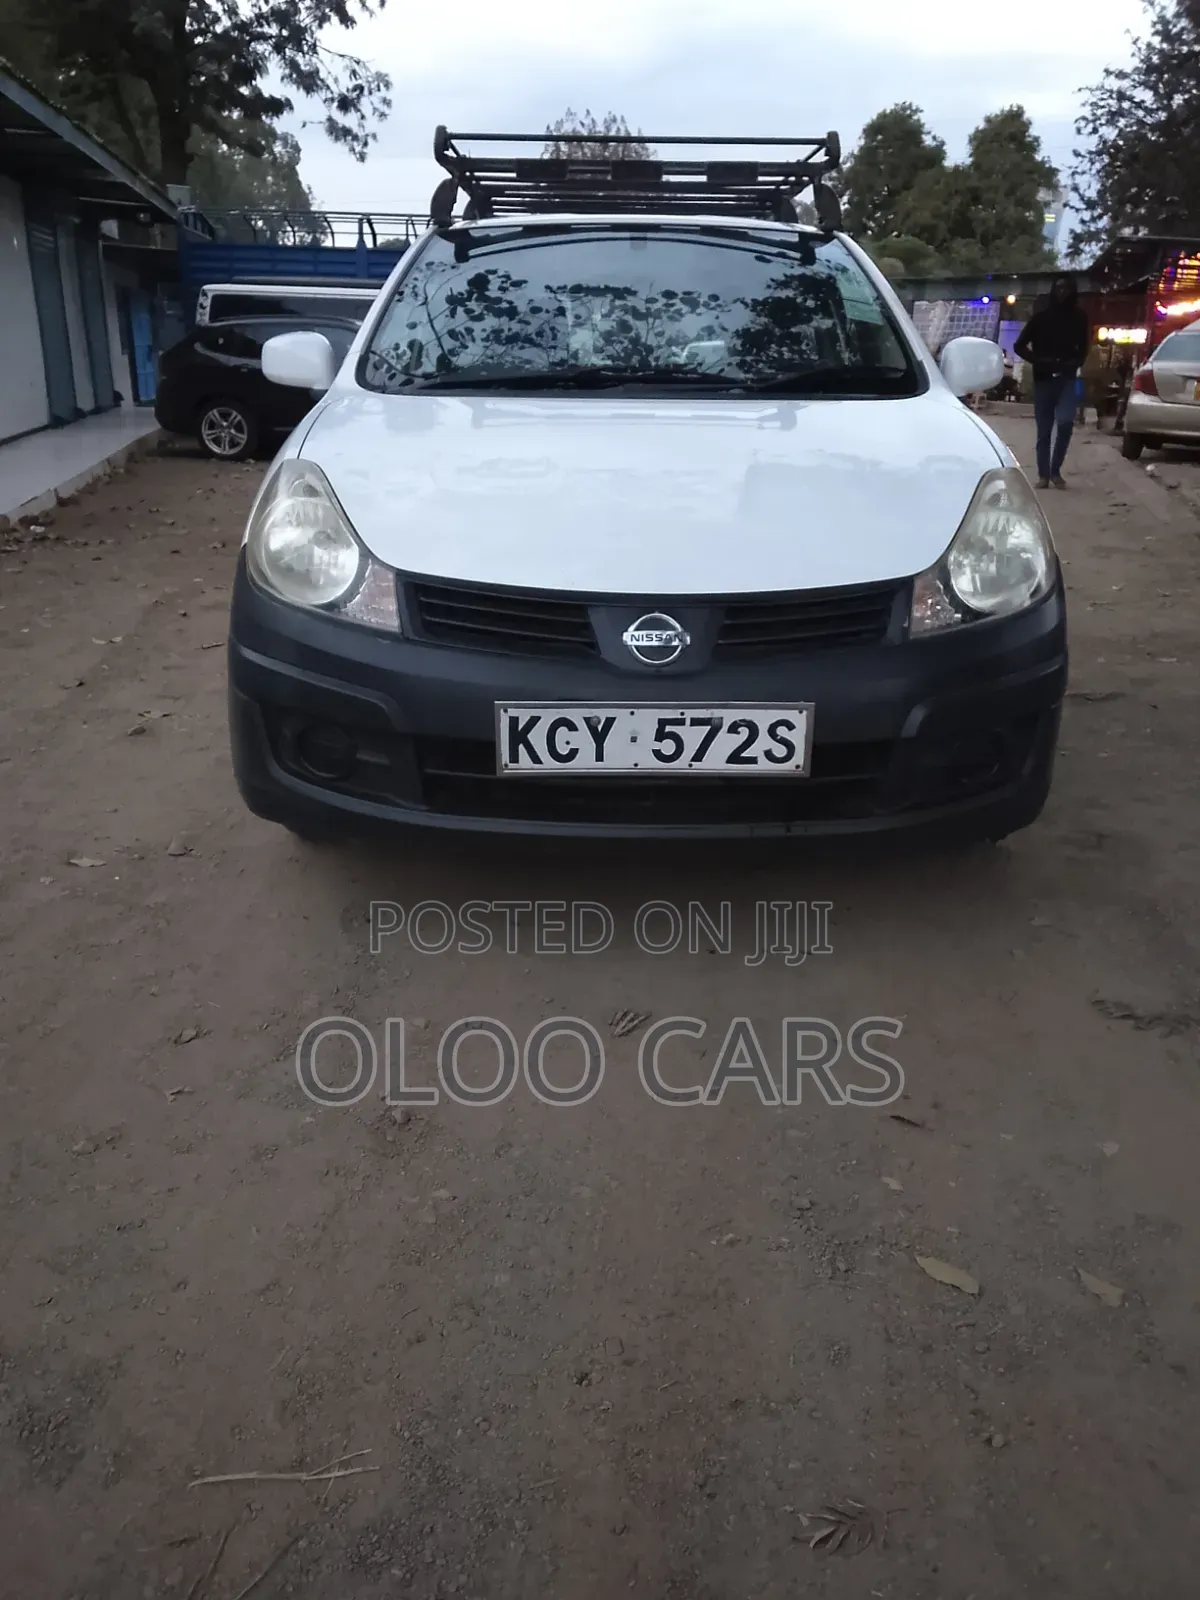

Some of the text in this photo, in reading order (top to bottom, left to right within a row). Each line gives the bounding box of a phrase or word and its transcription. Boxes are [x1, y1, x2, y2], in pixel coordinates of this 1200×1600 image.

[630, 633, 684, 643] NISSAN
[508, 715, 797, 765] KCY 572S
